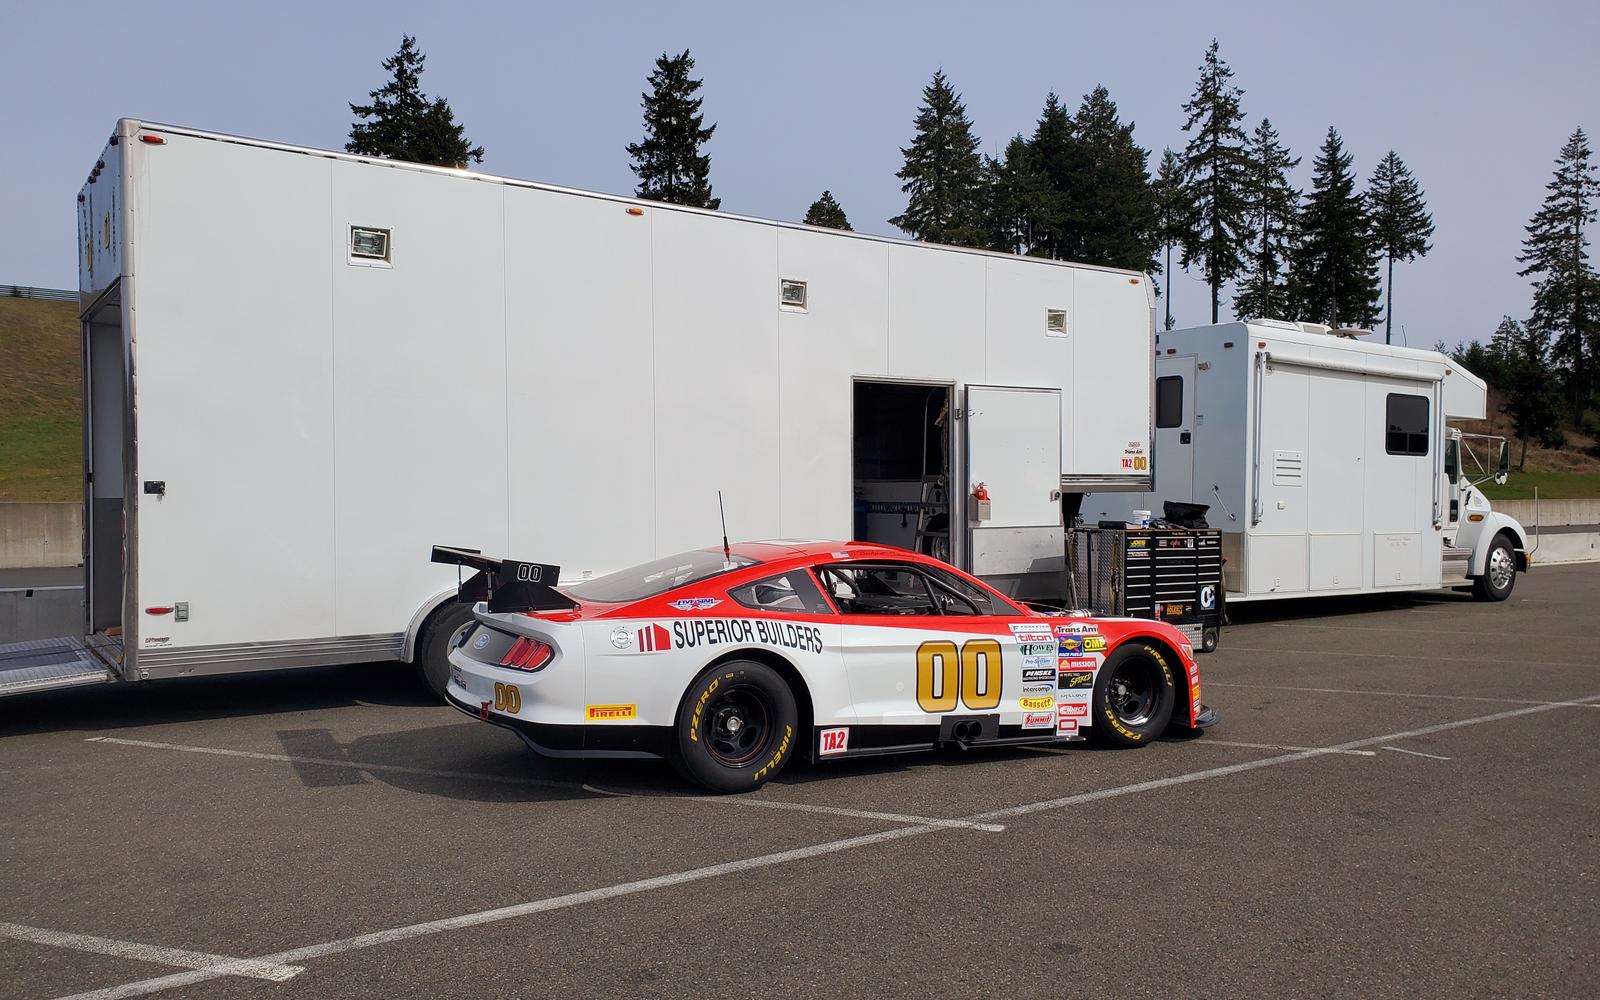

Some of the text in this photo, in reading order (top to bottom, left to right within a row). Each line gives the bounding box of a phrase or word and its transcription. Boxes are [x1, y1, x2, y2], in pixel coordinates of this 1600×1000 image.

[1122, 458, 1133, 468] TA2
[1133, 456, 1147, 470] 00
[517, 563, 542, 582] 00
[1057, 625, 1081, 633] Trans
[1082, 624, 1097, 633] Am
[673, 619, 823, 654] SUPERIOR BUILDERS
[1018, 634, 1052, 642] tilton
[1084, 637, 1104, 649] OMP
[1143, 645, 1173, 687] PIRELLI
[916, 639, 1003, 713] 00
[1022, 698, 1051, 709] Bassett
[589, 706, 632, 718] PIRELLI
[823, 731, 846, 751] TA2
[753, 723, 793, 782] PIRELLI
